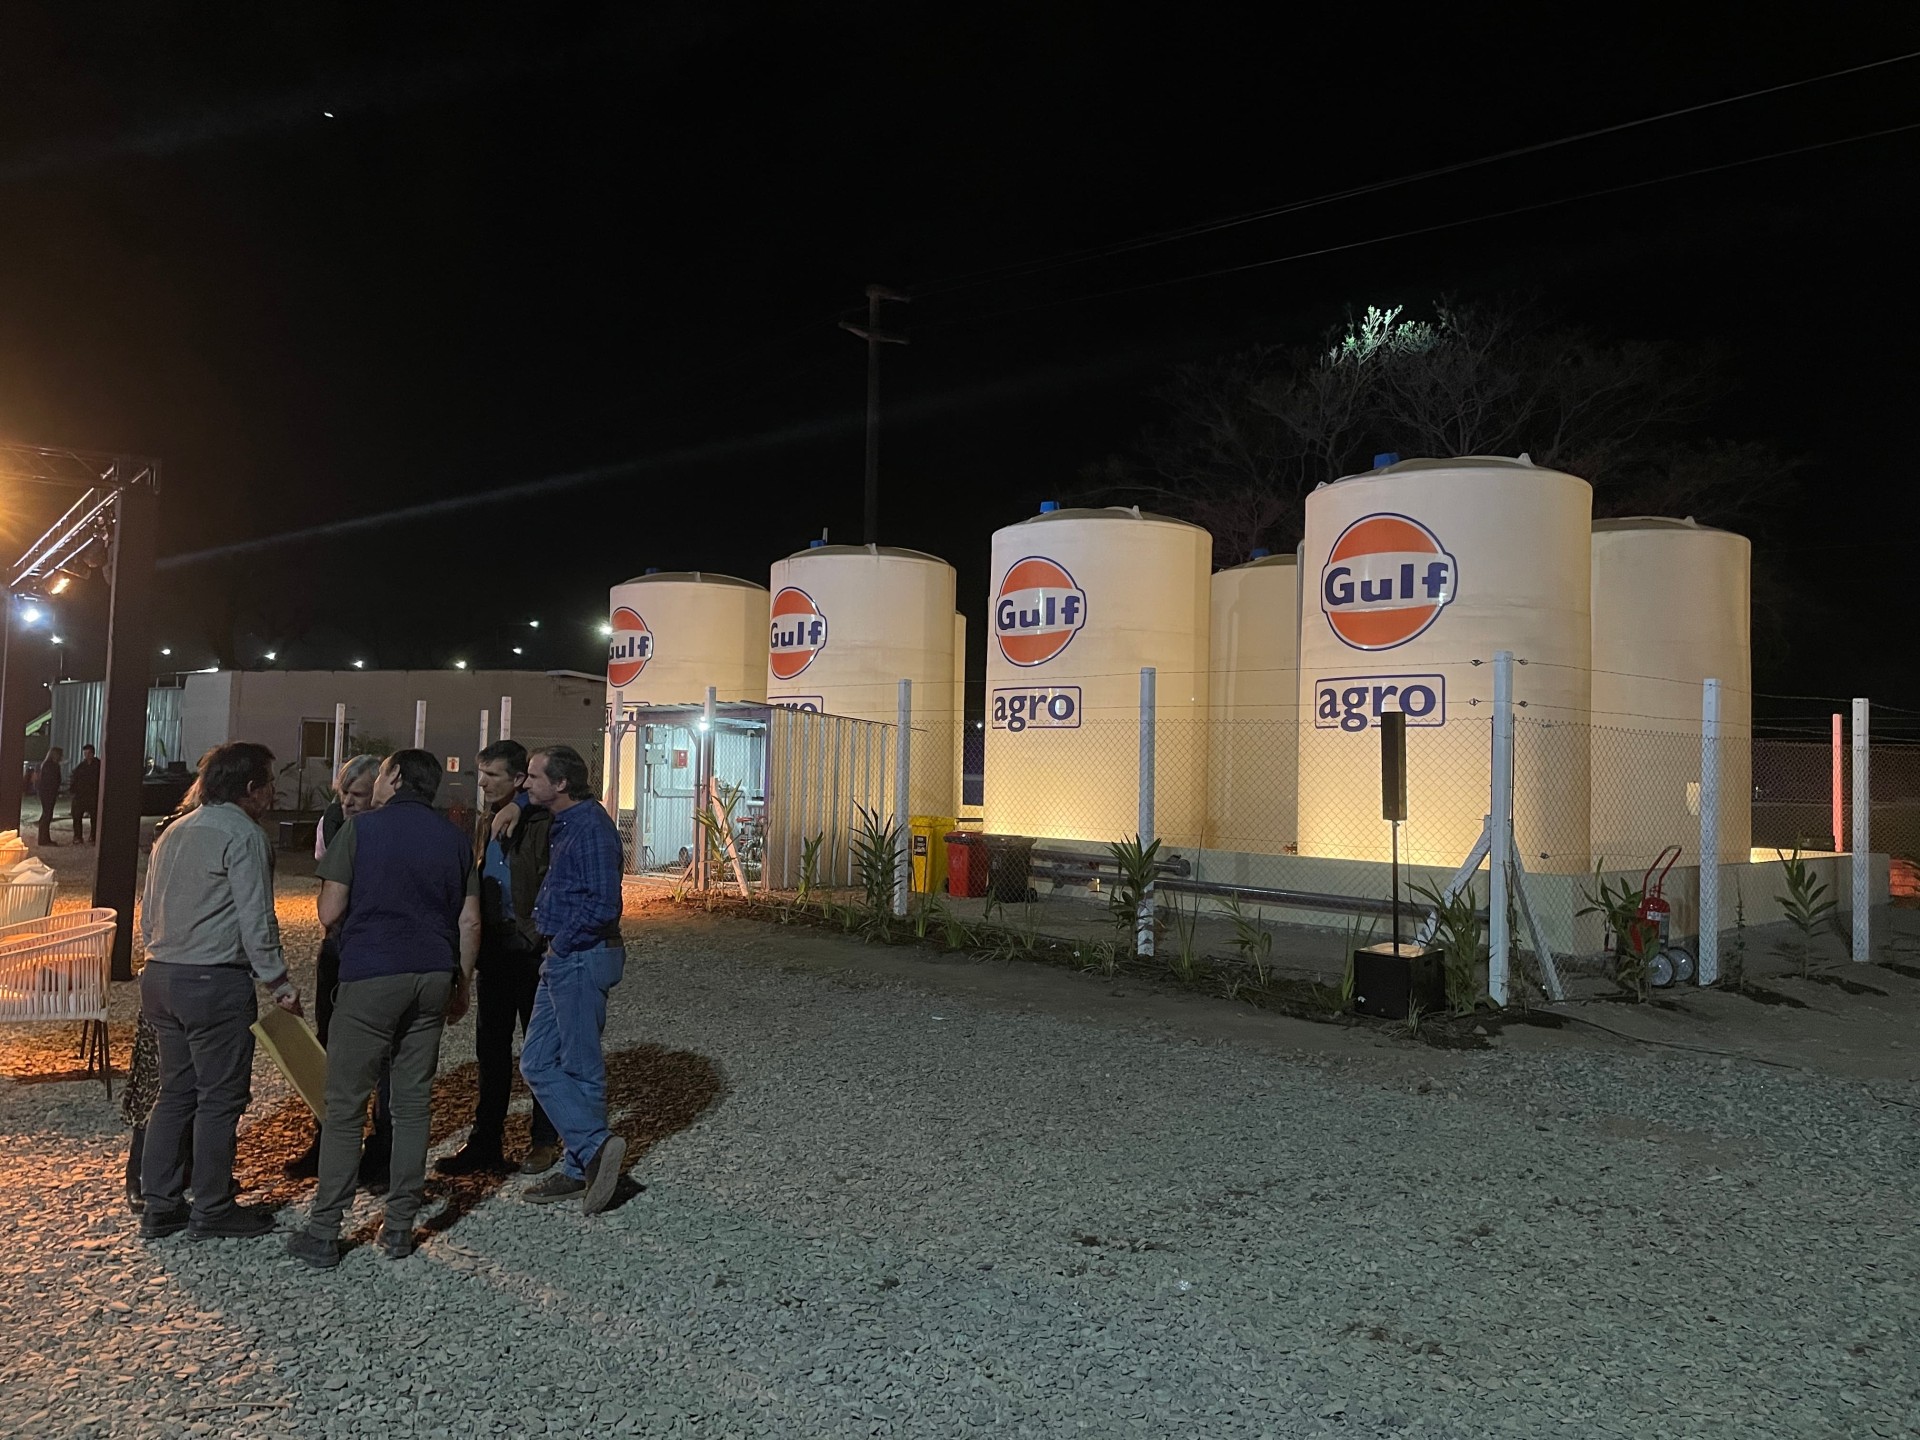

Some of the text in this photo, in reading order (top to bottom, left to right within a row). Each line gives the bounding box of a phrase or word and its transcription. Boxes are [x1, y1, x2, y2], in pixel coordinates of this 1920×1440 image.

[1325, 562, 1449, 605] Gulf
[997, 595, 1080, 630] Gulf
[771, 620, 823, 648] Gulf
[994, 694, 1075, 732] agro
[1318, 684, 1437, 732] agro
